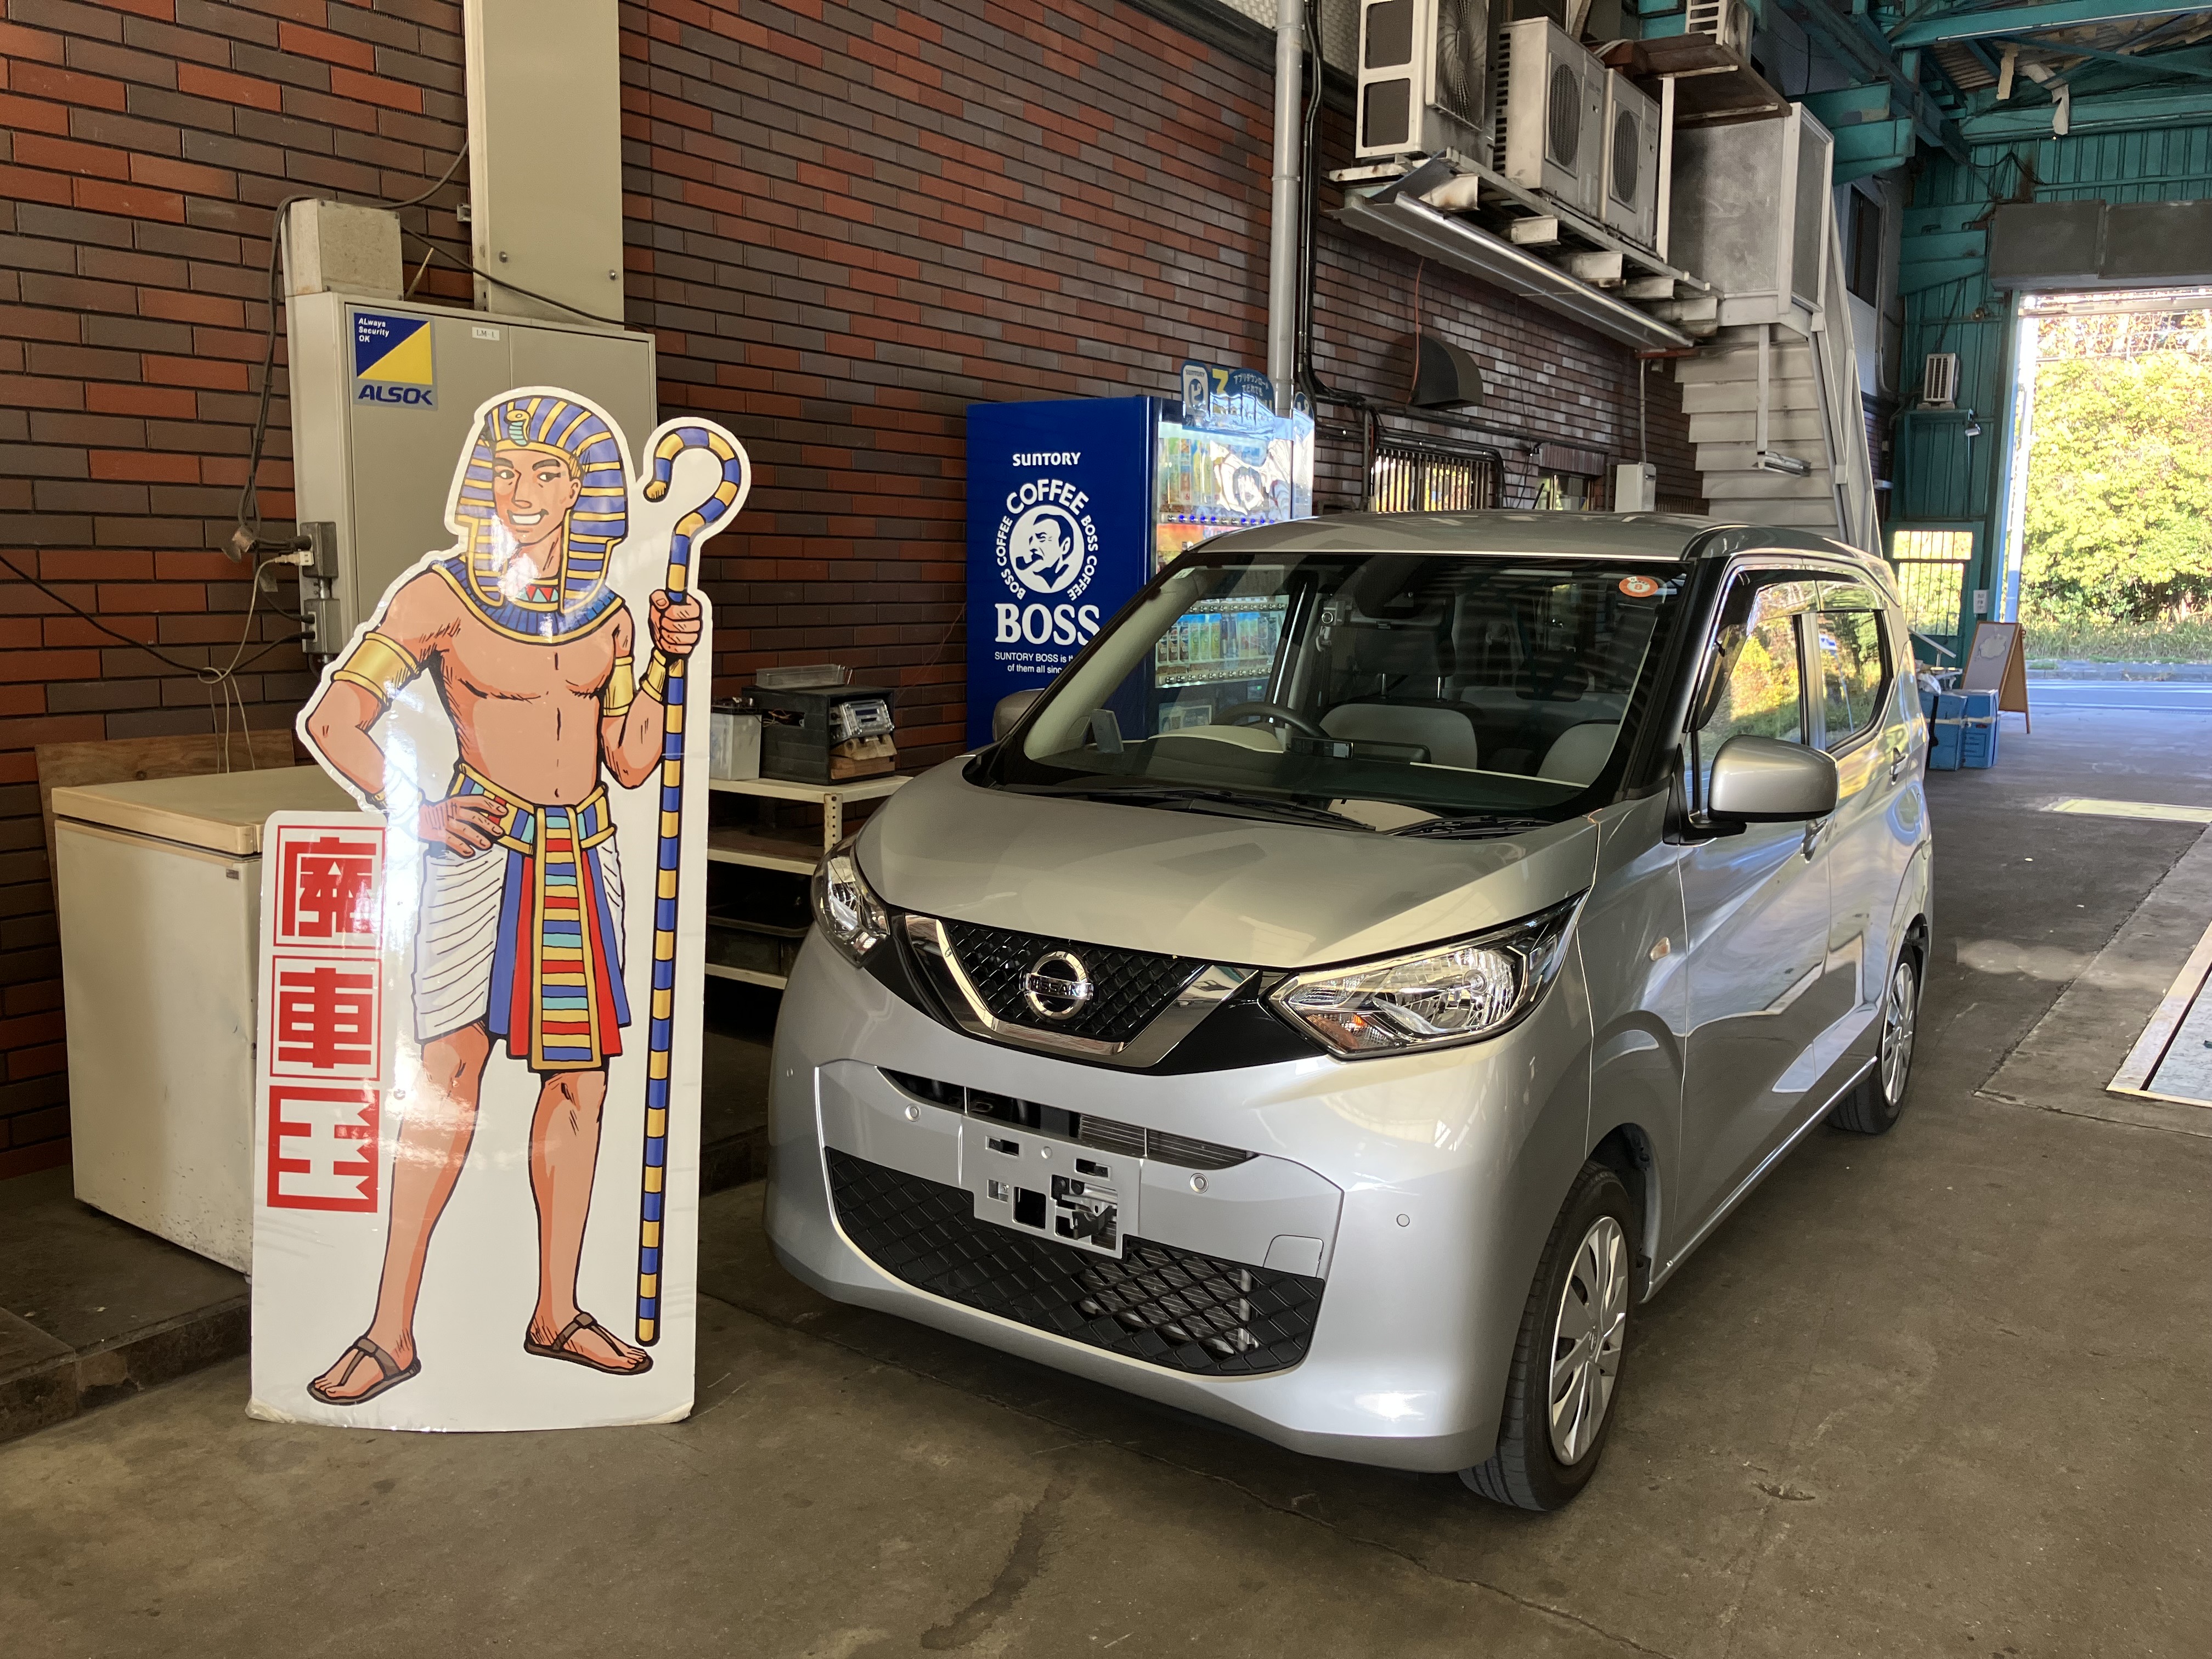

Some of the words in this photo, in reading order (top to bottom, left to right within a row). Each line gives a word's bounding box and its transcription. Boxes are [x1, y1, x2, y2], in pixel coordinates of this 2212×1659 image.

[358, 326, 390, 338] Security
[357, 383, 433, 406] ALSOK
[1012, 452, 1081, 466] SUNTORY
[1006, 479, 1089, 516] COFFEE
[996, 516, 1013, 566] COFFEE
[1081, 515, 1099, 551] BOSS
[1001, 568, 1026, 600] BOSS
[1066, 555, 1097, 601] COFFEE
[995, 602, 1100, 646] BOSS
[995, 651, 1034, 661] SUNTORY
[1035, 653, 1058, 663] BOSS
[1060, 654, 1067, 663] is
[1007, 663, 1015, 672] of
[1016, 664, 1035, 673] them
[1036, 665, 1045, 673] all
[1047, 665, 1062, 674] sinc
[1030, 977, 1080, 998] NISSAN
